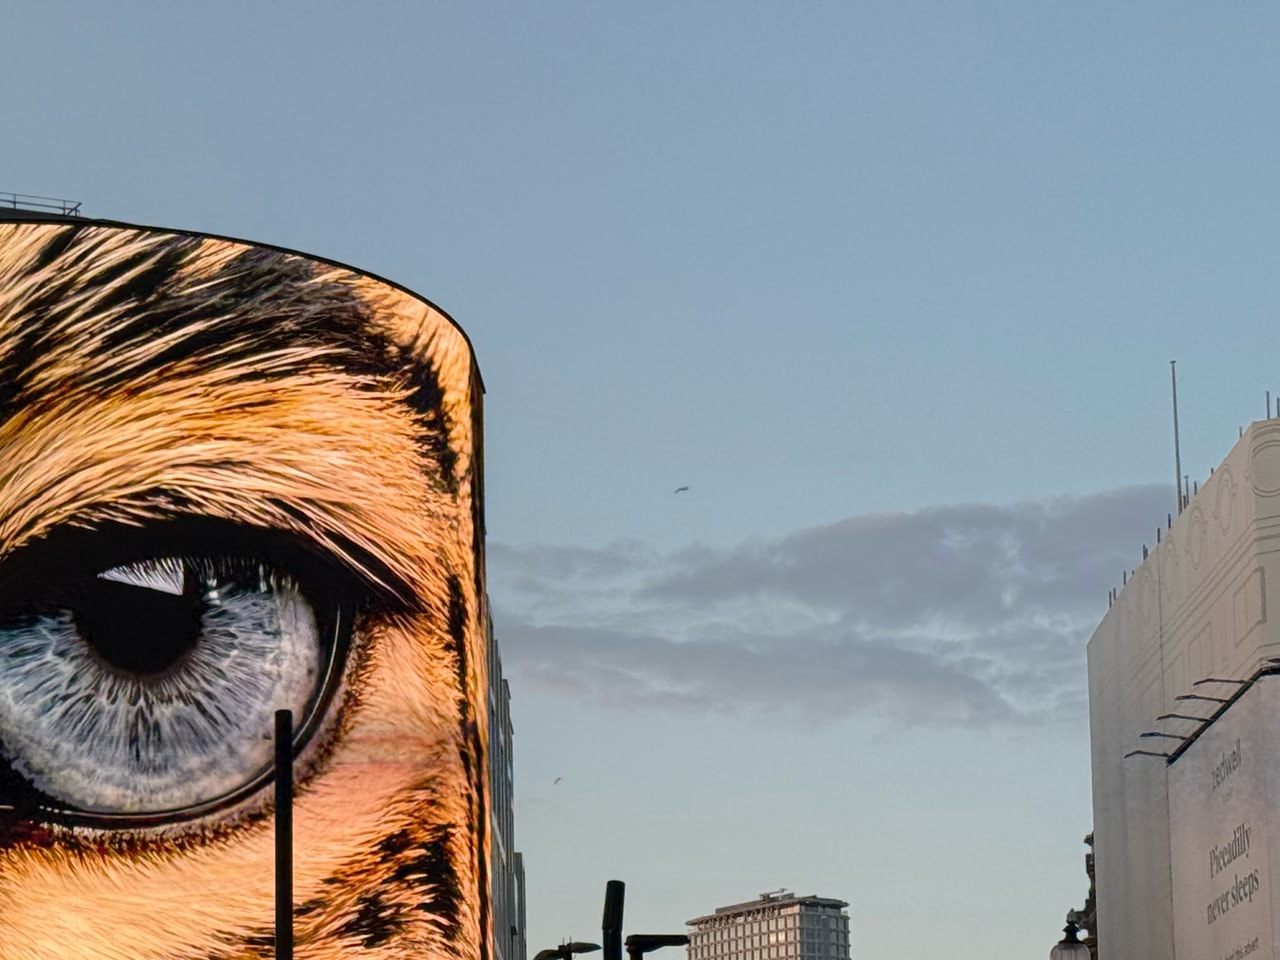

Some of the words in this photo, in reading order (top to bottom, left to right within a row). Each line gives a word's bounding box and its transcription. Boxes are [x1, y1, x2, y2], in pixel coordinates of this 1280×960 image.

[1209, 822, 1252, 880] Piccadilly
[1207, 890, 1230, 926] never
[1230, 868, 1260, 908] sleeps
